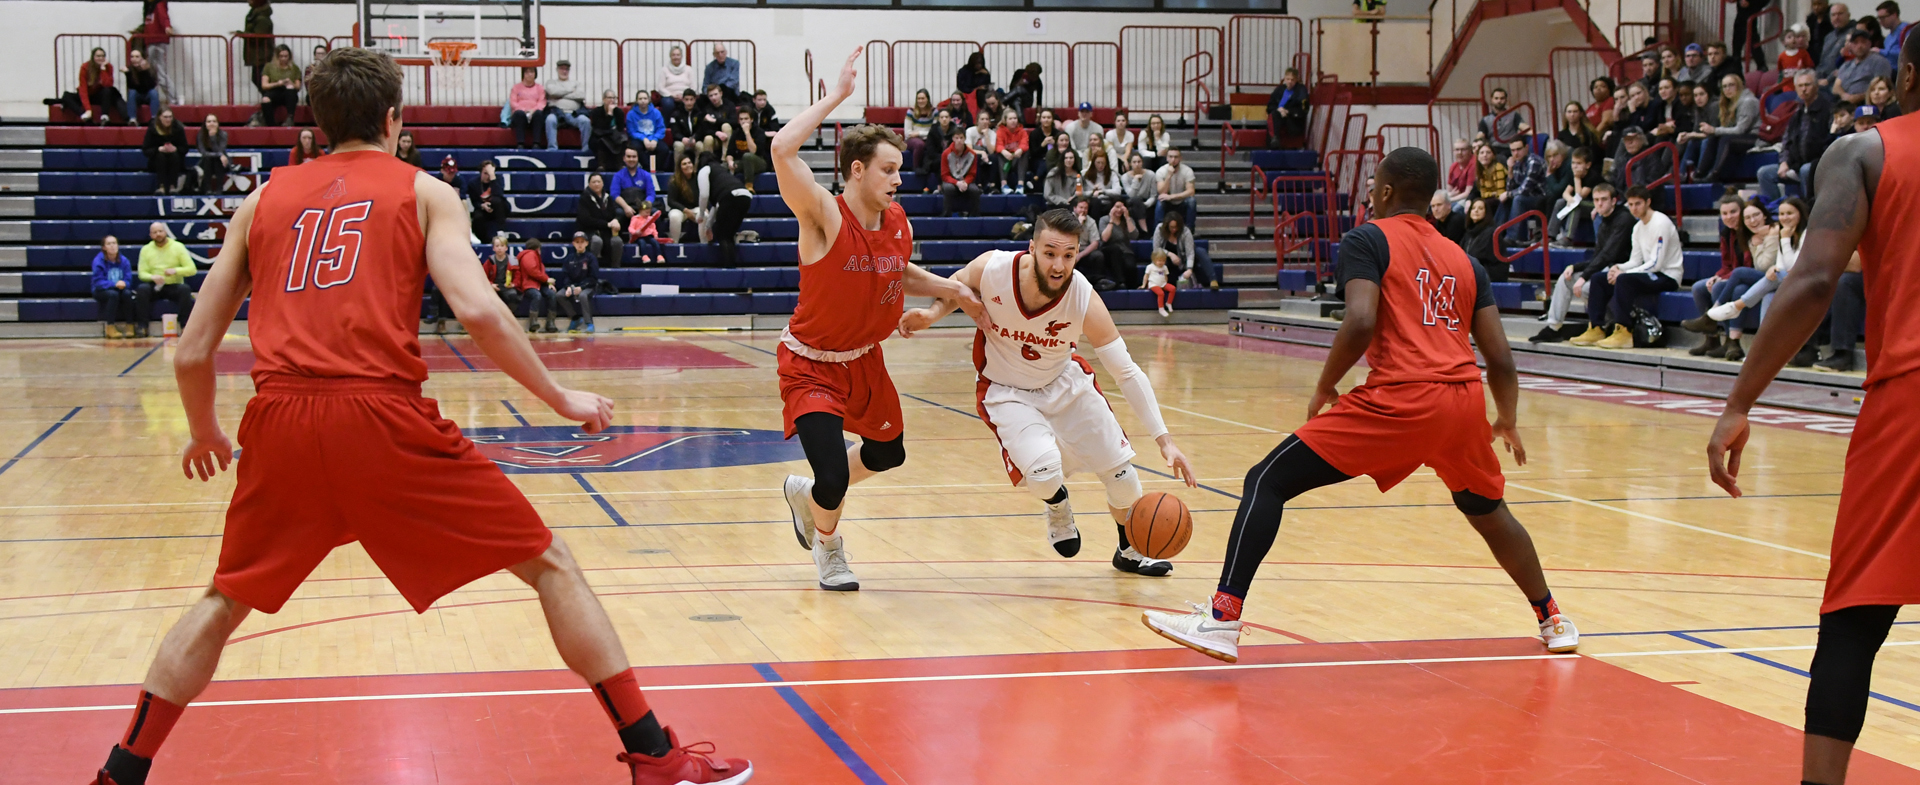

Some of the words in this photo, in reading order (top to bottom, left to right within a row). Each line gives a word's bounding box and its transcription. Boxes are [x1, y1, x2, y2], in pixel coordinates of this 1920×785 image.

[1033, 17, 1041, 29] 6
[284, 199, 374, 294] 15
[843, 254, 905, 274] ACADIA
[1415, 267, 1460, 331] 14
[1021, 343, 1041, 360] 6
